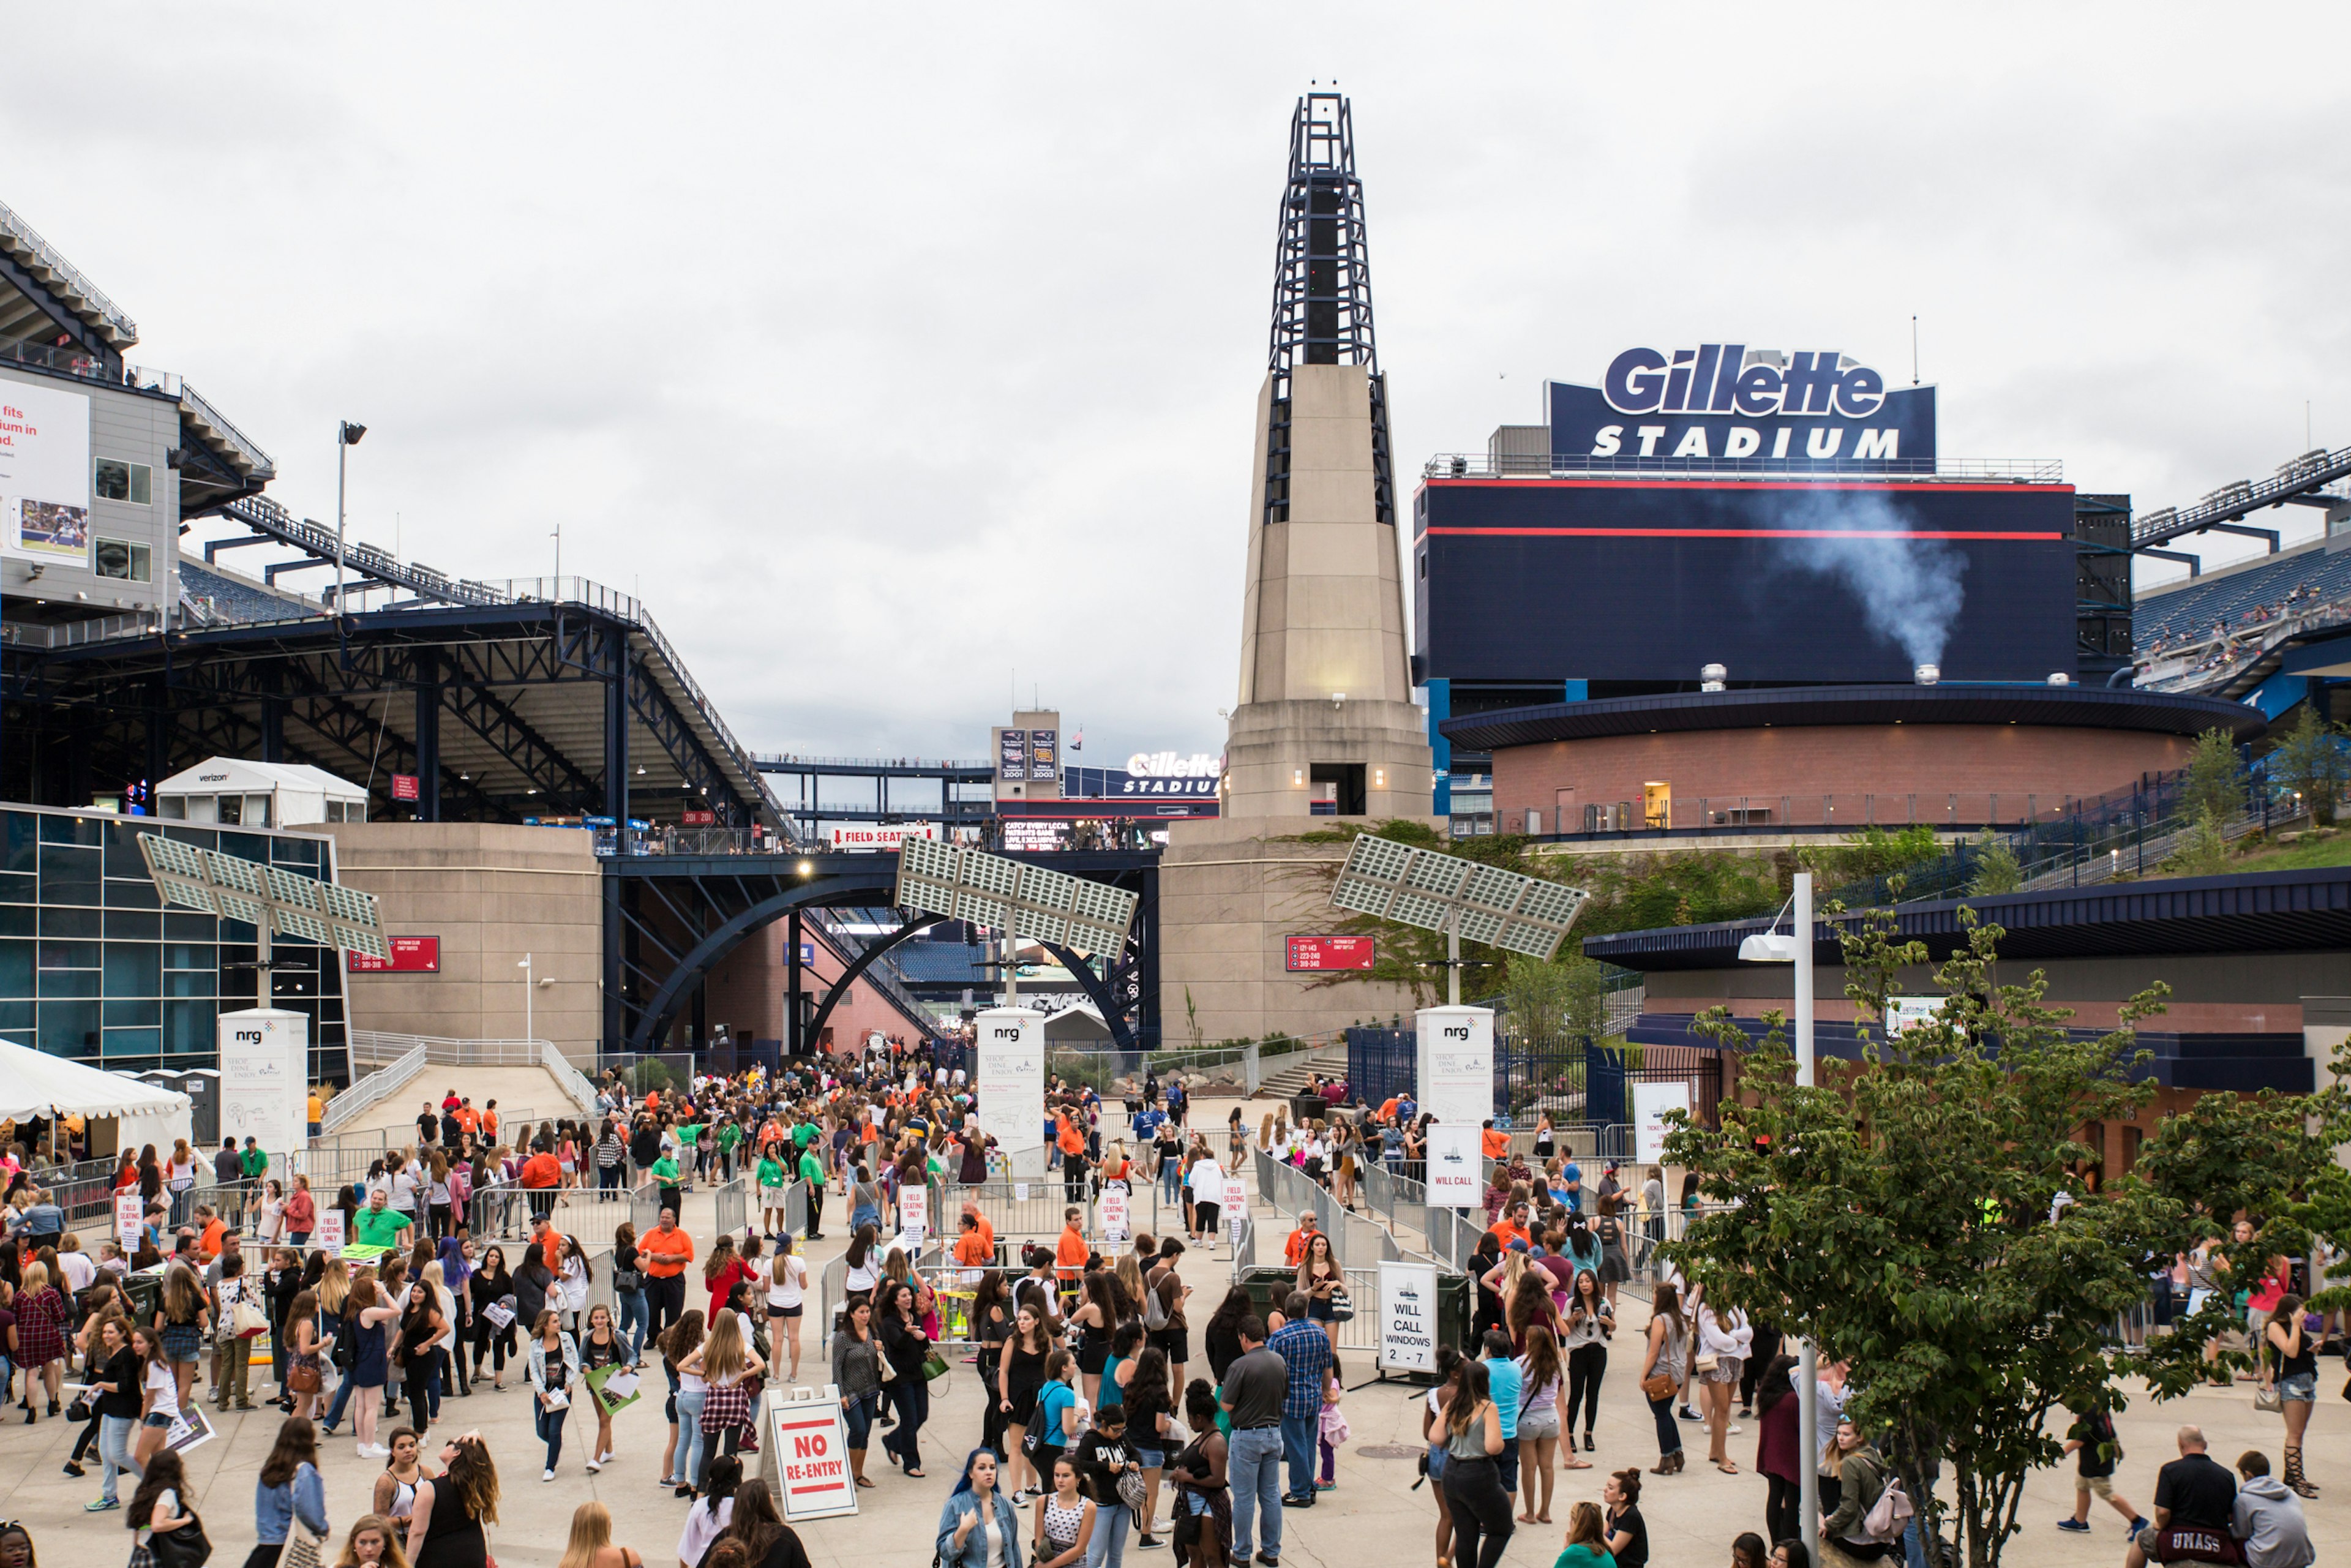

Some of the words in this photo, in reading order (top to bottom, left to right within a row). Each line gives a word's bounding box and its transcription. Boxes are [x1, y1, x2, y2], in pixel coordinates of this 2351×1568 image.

[1602, 342, 1886, 418] Gillette
[3, 405, 23, 418] fits
[25, 424, 37, 435] in
[0, 435, 14, 446] d.
[1591, 426, 1899, 459] STADIUM
[1127, 752, 1220, 778] Gillette
[686, 813, 696, 822] 201
[701, 813, 711, 822] 201
[846, 832, 873, 842] FIELD
[877, 831, 920, 842] SEAT
[236, 1031, 262, 1044] nrg
[995, 1029, 1019, 1041] nrg
[1445, 1027, 1468, 1040] nrg
[1395, 1304, 1421, 1316] WILL
[1394, 1320, 1422, 1333] CALL
[1386, 1334, 1430, 1347] WINDOWS
[1390, 1349, 1396, 1359] 2
[1416, 1353, 1423, 1363] 7
[794, 1434, 827, 1458] NO
[1095, 1444, 1127, 1465] PIN
[786, 1460, 842, 1480] RE-ENTRY
[2172, 1532, 2221, 1553] UMASS
